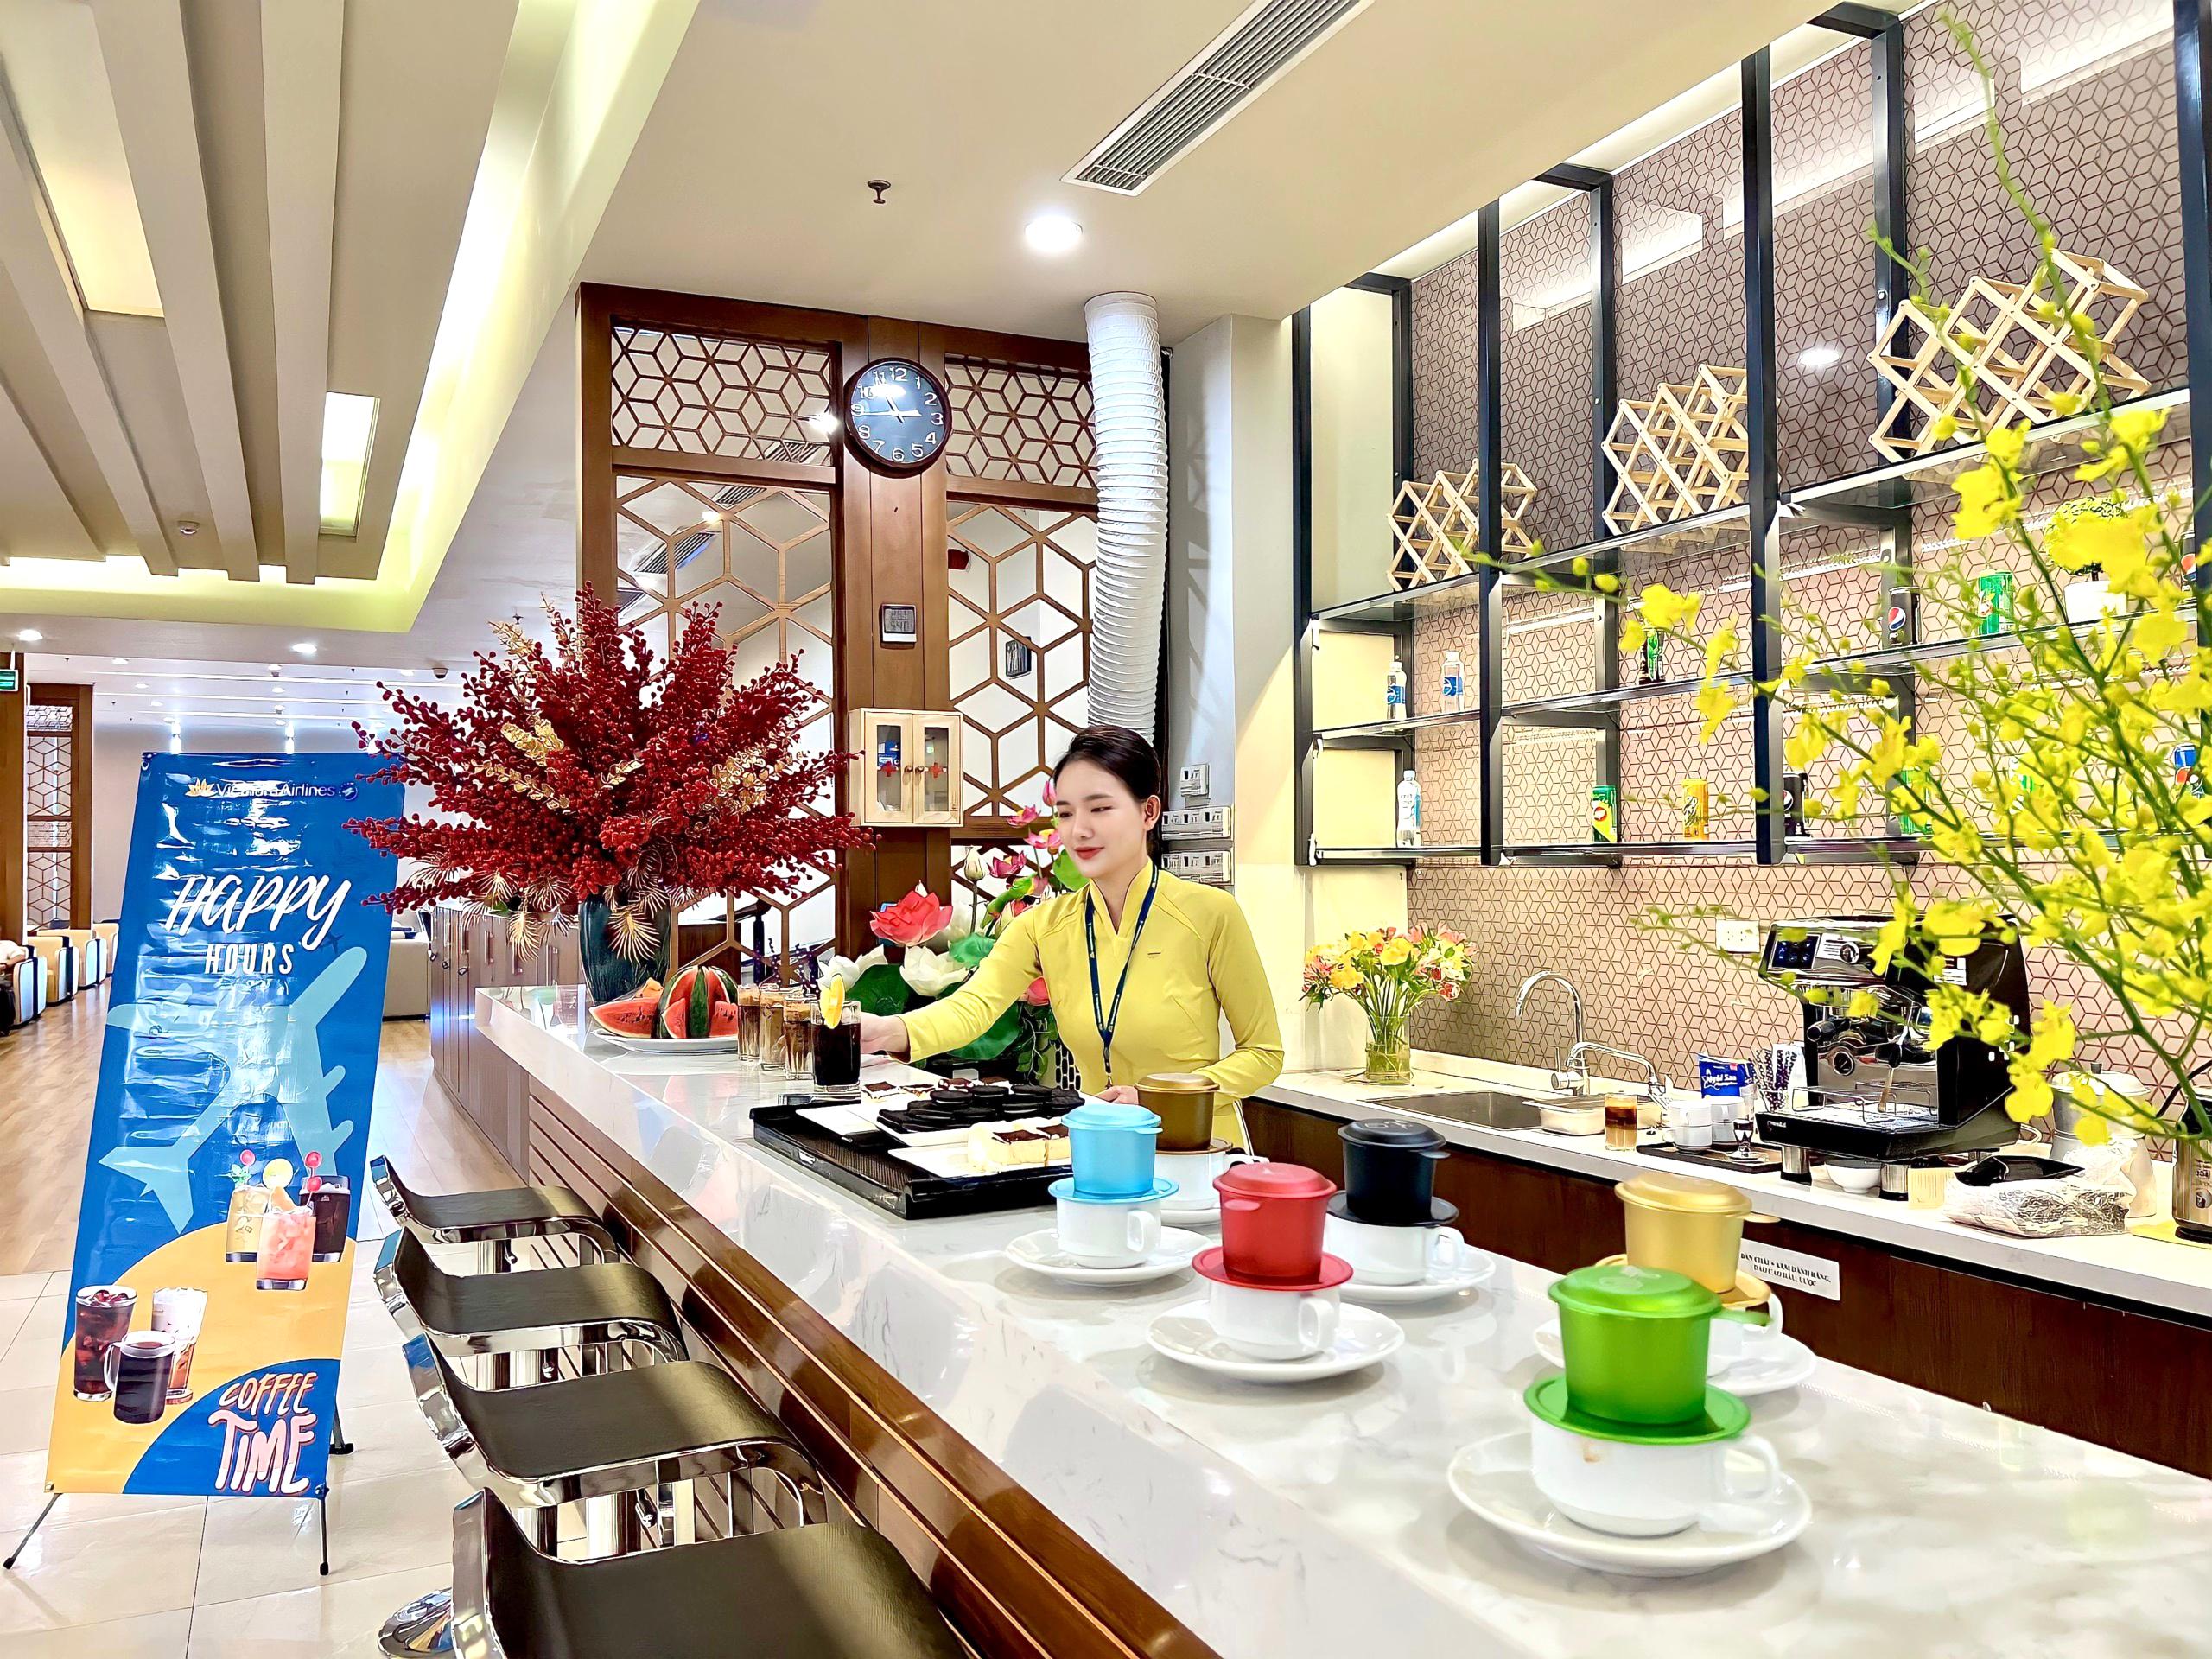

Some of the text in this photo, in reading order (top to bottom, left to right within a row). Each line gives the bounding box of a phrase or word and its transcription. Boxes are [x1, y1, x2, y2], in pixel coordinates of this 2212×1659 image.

[873, 370, 886, 385] 11
[889, 366, 908, 382] 12
[915, 375, 921, 390] 1
[924, 392, 938, 405] 2
[851, 404, 865, 416] 9
[931, 412, 944, 425] 3
[858, 424, 871, 439] 8
[925, 431, 937, 444] 4
[872, 439, 886, 454] 7
[911, 442, 924, 458] 5
[892, 448, 905, 462] 6
[216, 782, 336, 797] Vienam Airlines
[204, 943, 295, 976] HOURS
[219, 1372, 318, 1417] COFFEE
[207, 1409, 318, 1495] TIME
